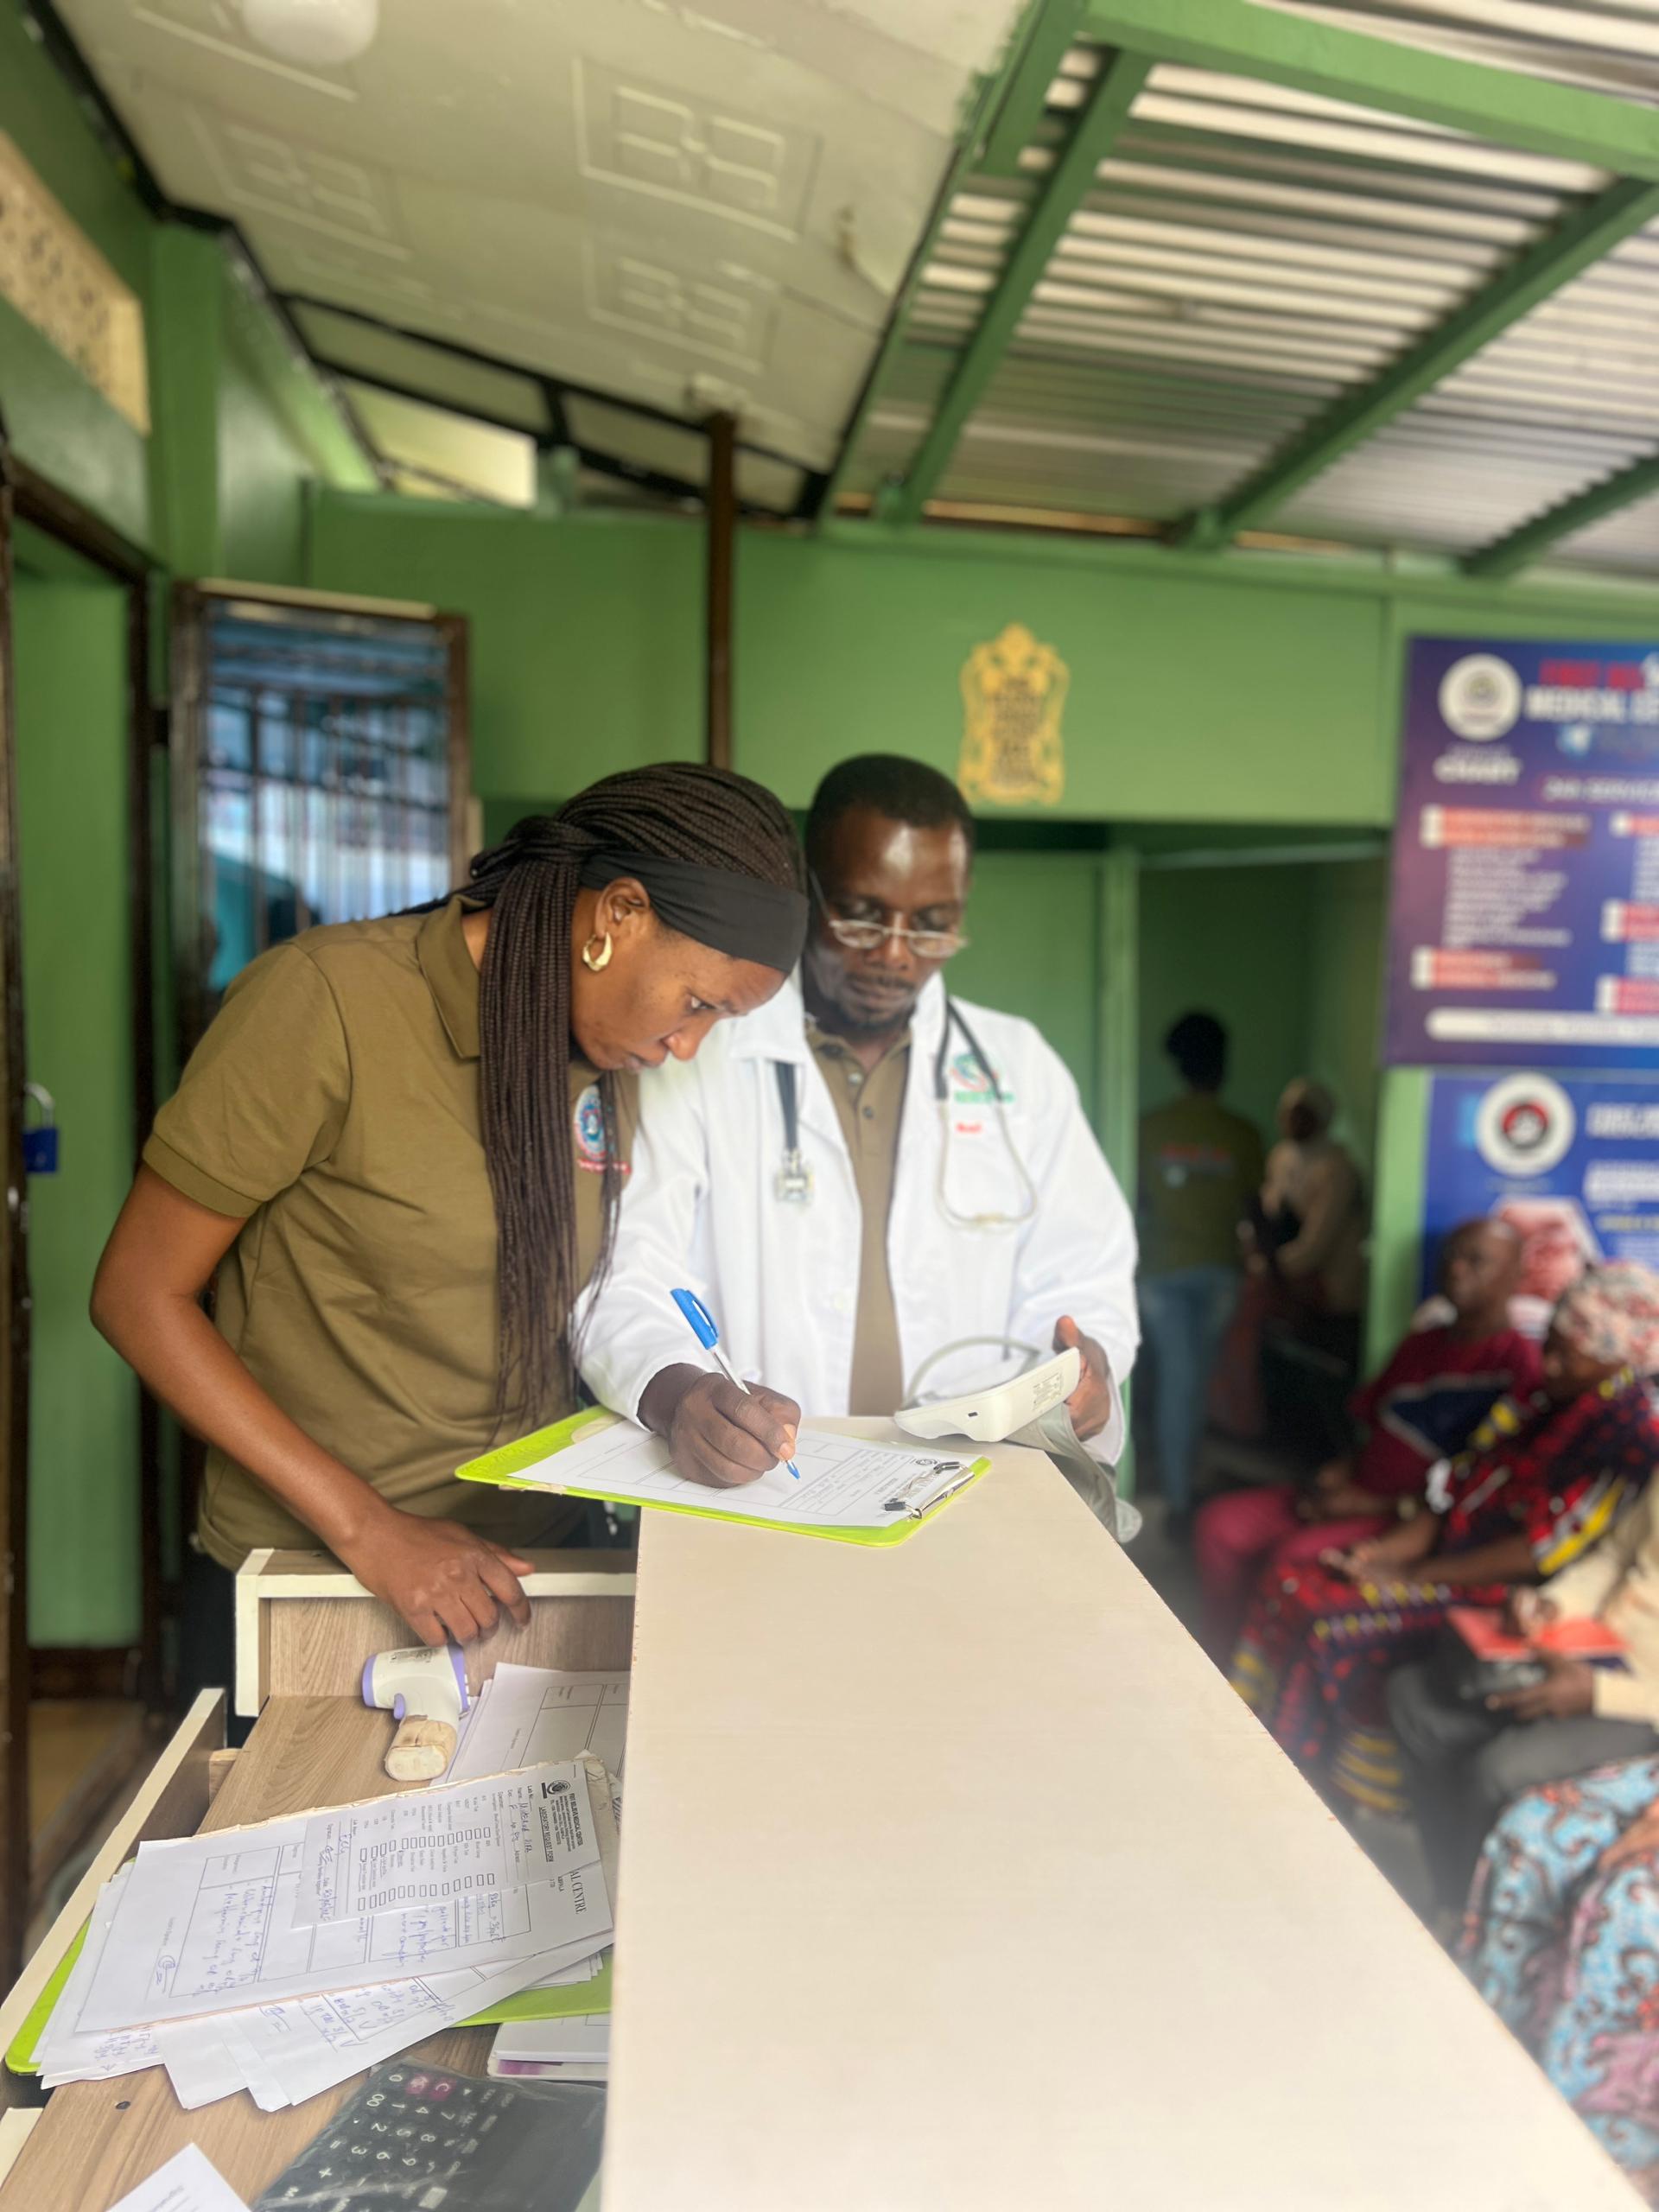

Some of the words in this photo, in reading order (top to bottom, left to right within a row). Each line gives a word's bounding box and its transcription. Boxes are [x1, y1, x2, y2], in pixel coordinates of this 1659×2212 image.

[571, 1881, 587, 1914] CENTRE
[366, 2094, 385, 2107] 00
[371, 2122, 387, 2132] 2
[421, 2133, 435, 2142] 8
[351, 2145, 367, 2155] 3
[402, 2158, 416, 2166] 9
